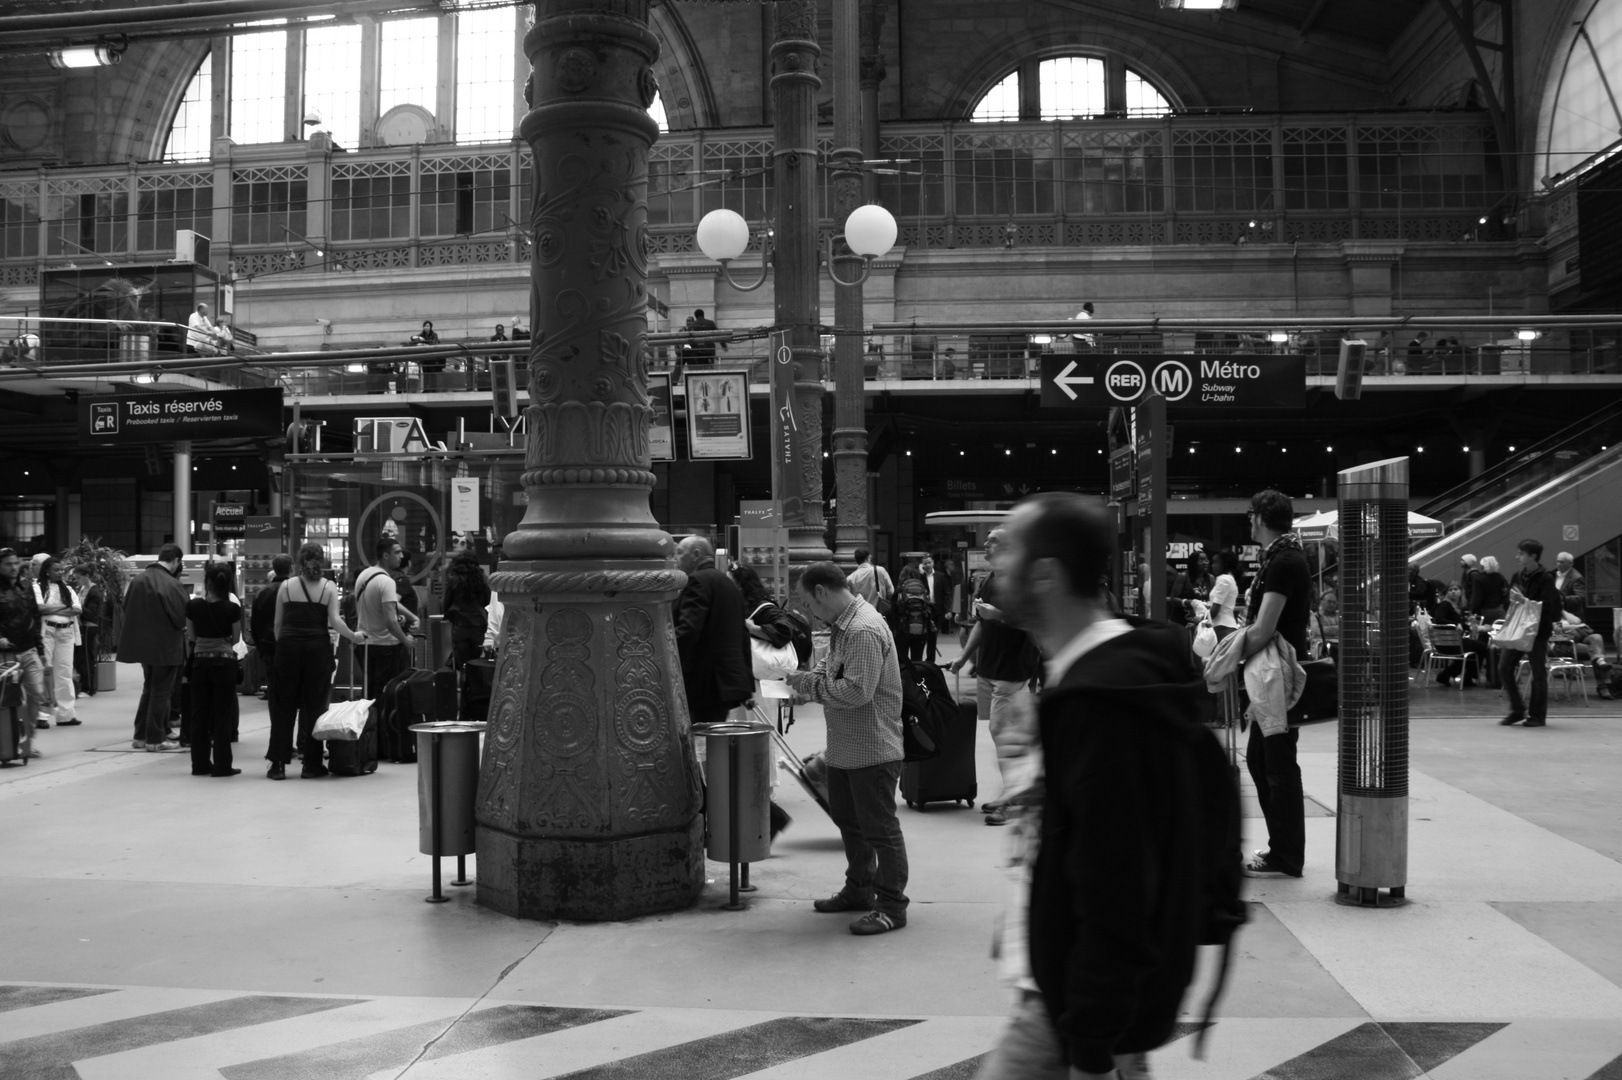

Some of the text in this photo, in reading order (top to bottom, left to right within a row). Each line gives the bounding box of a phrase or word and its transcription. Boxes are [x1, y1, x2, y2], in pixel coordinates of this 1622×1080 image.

[1200, 360, 1261, 379] Métro
[1110, 374, 1141, 387] RER
[1160, 369, 1183, 392] M
[1201, 383, 1236, 393] Subway
[1201, 393, 1235, 402] U-bahn
[126, 397, 223, 415] Taxis réservés
[107, 415, 115, 428] R
[126, 417, 159, 426] Prebooked
[160, 416, 175, 424] taxis
[182, 414, 222, 423] Reservierten
[223, 413, 238, 421] taxis
[306, 414, 524, 453] THALY
[784, 424, 792, 464] THALYS
[947, 480, 976, 491] Billets
[215, 505, 244, 516] Accueil
